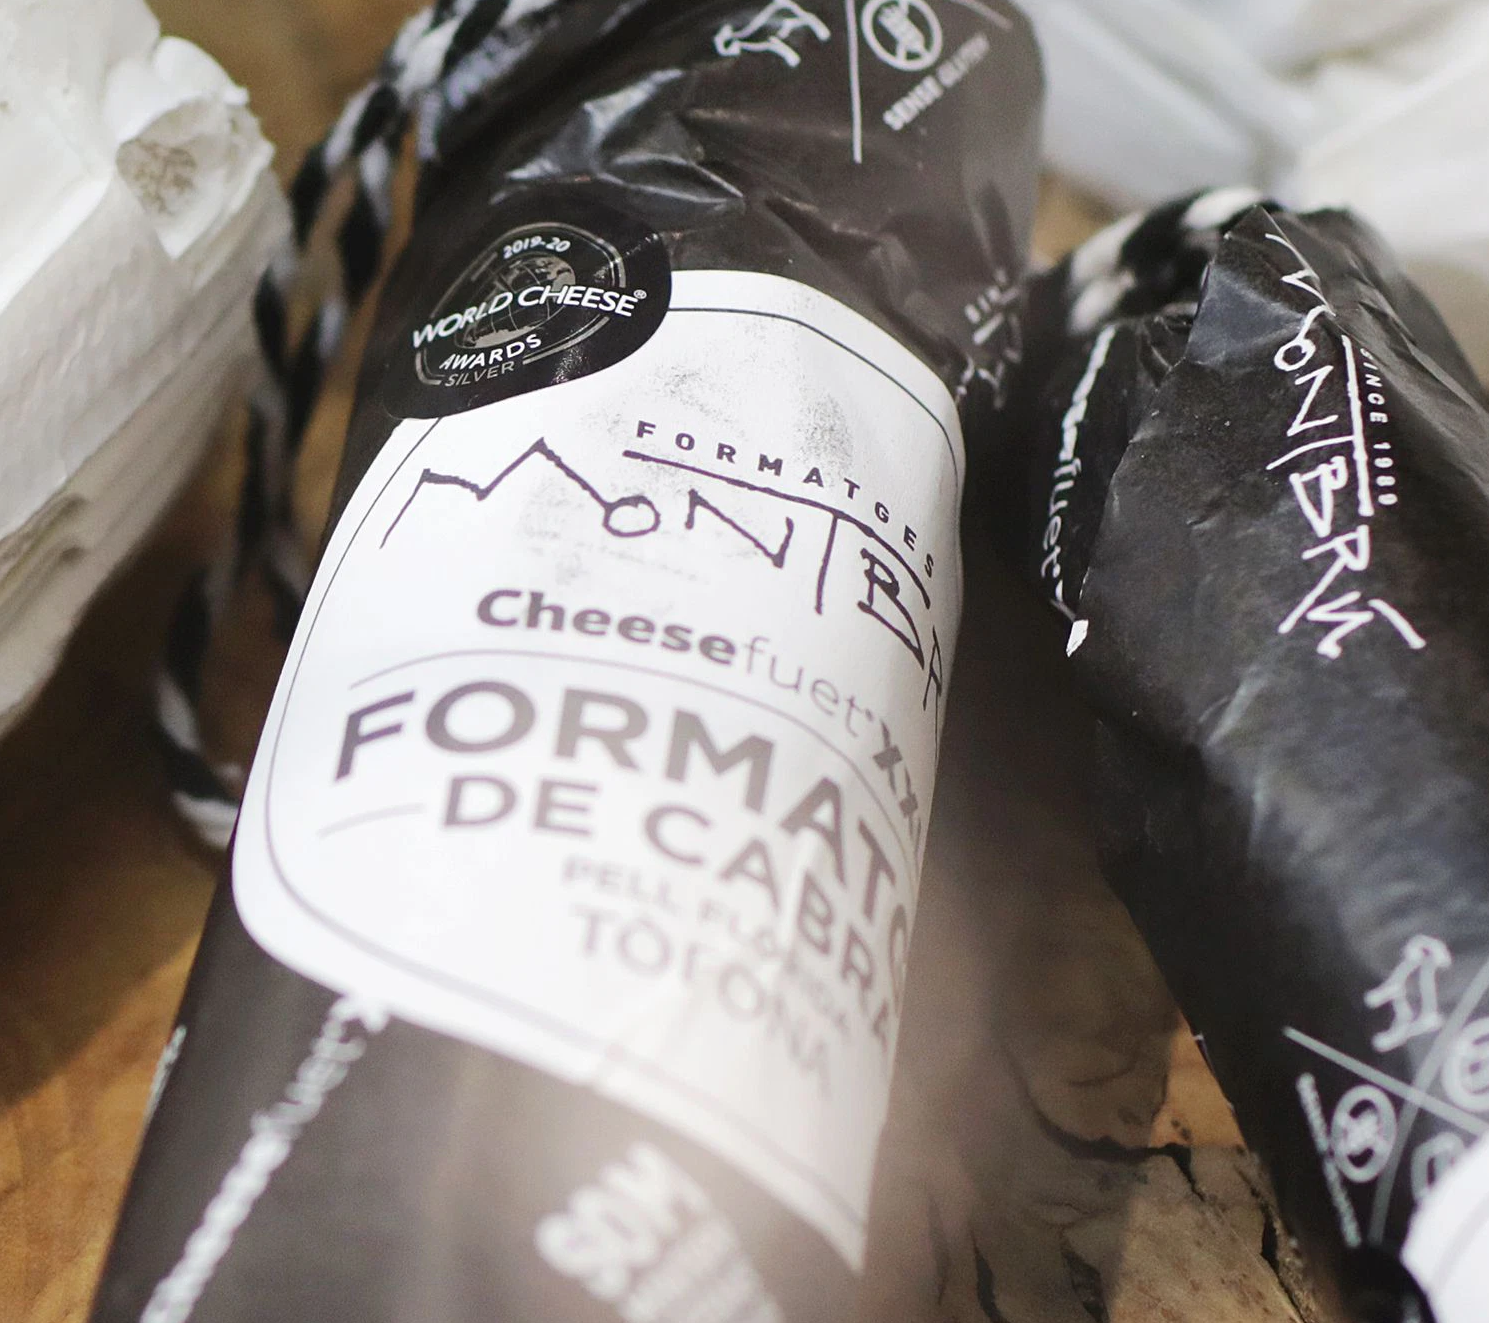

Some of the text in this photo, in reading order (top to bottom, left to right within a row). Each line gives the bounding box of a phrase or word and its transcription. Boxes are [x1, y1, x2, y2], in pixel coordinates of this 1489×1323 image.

[503, 235, 572, 260] 2019-20
[411, 291, 514, 350] WORLD
[438, 333, 543, 371] AWARDS
[444, 360, 515, 387] SILVER
[1359, 347, 1389, 424] SINCE
[635, 420, 935, 579] FORMATGES
[442, 775, 602, 837] DE
